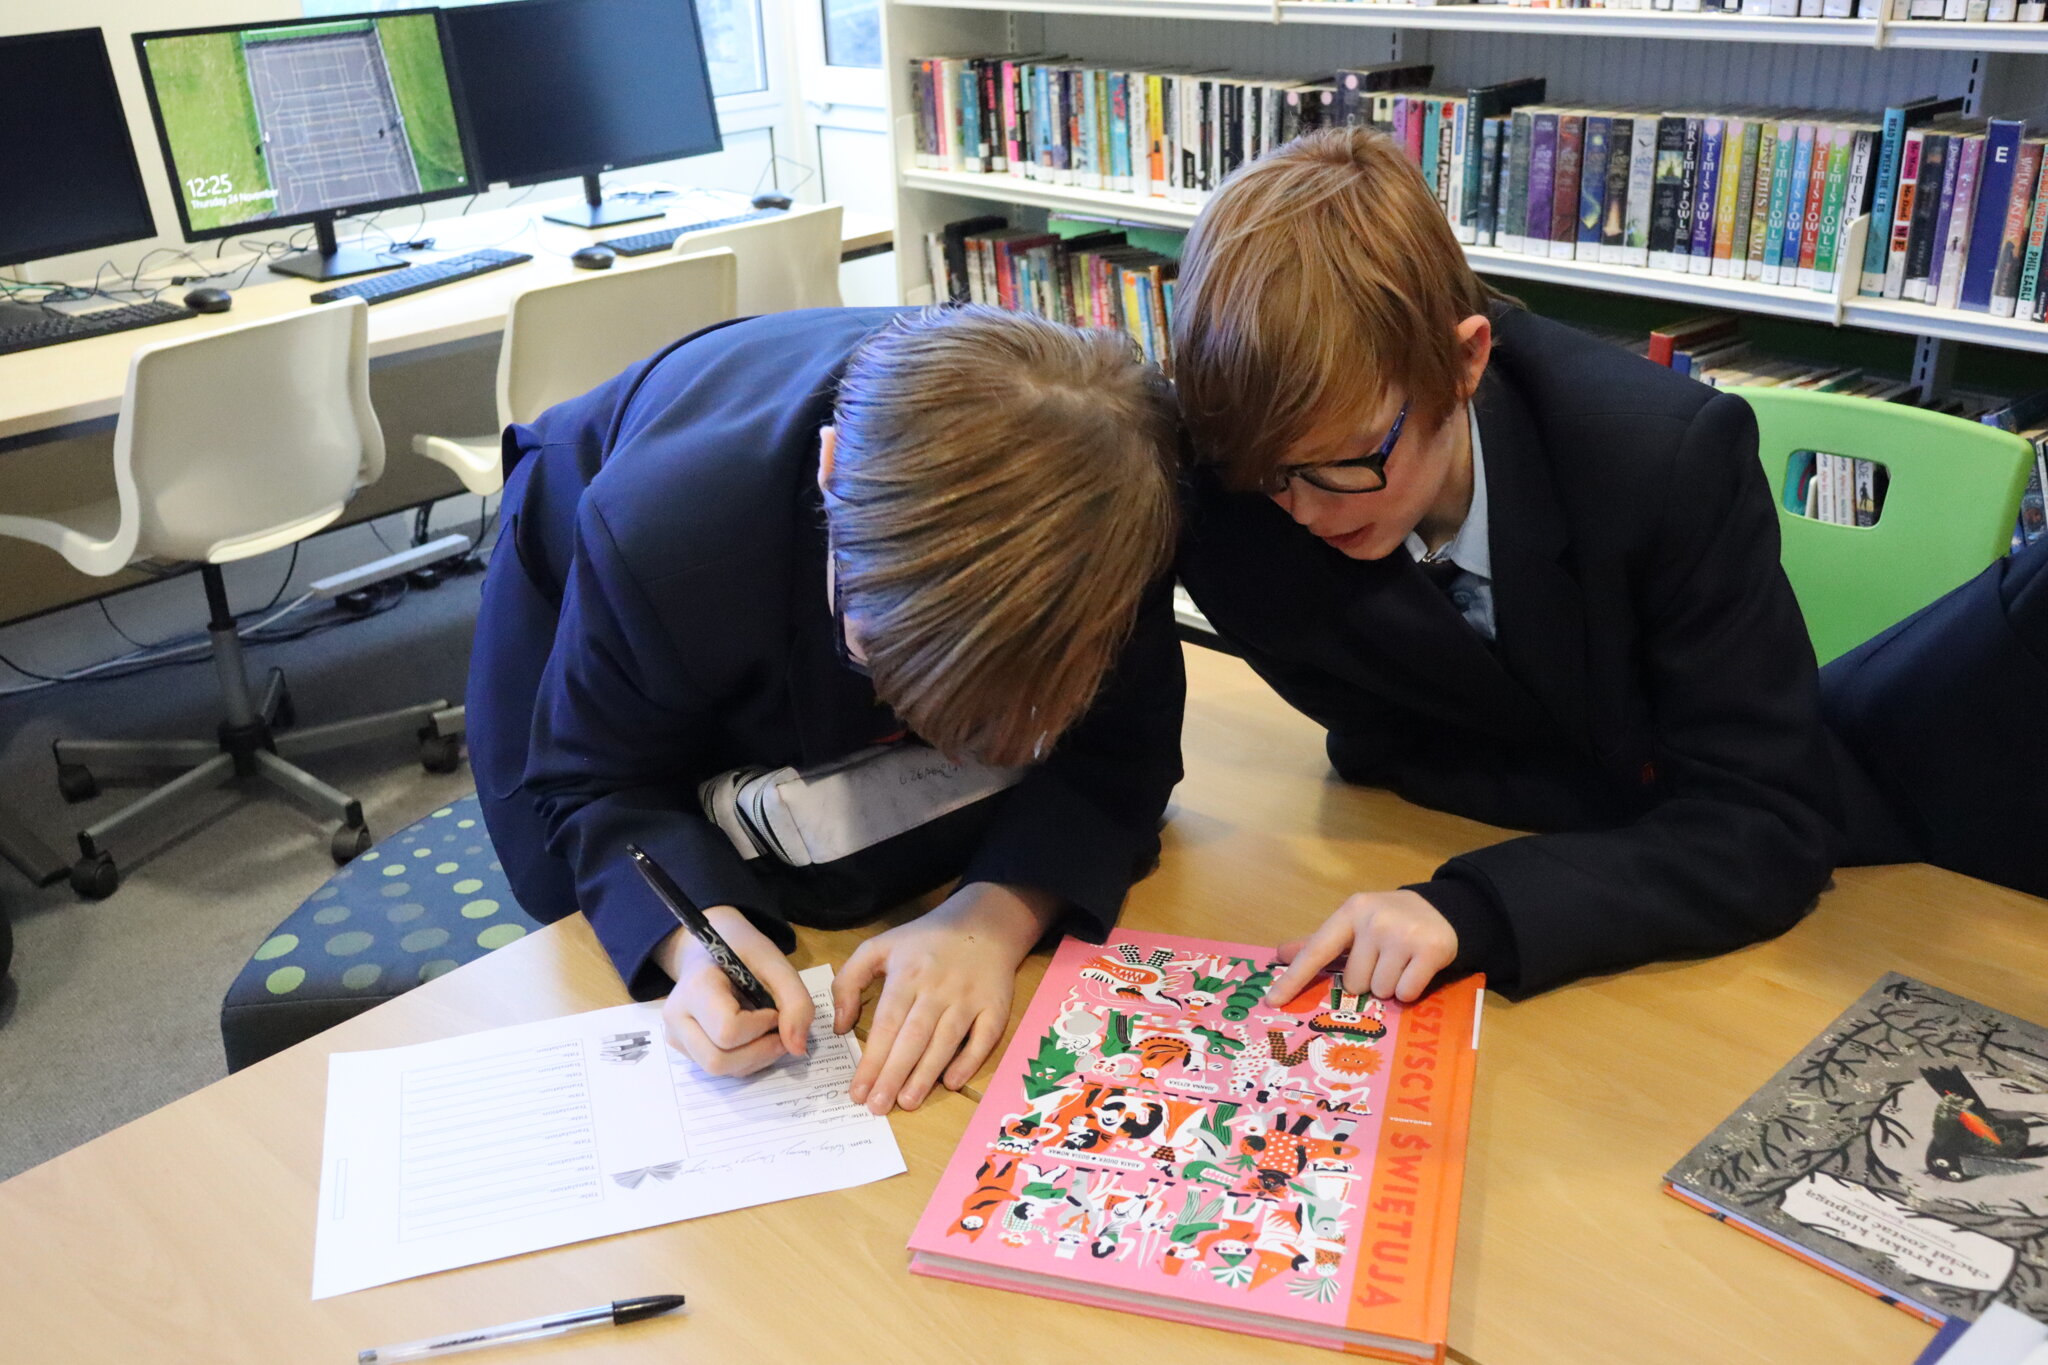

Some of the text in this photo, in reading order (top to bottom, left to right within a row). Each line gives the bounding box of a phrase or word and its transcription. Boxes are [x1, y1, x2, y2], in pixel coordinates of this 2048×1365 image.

[1682, 120, 1697, 188] ARTEMIS
[1702, 134, 1717, 190] RTEMIS
[1775, 140, 1793, 198] RTEMIS
[1812, 141, 1826, 200] RTEMIS
[1850, 134, 1869, 203] ARTEMIS
[1882, 138, 1894, 174] BETWEEN
[1995, 147, 2009, 163] E
[186, 173, 233, 198] 12:25
[191, 197, 227, 210] Thursday
[239, 188, 279, 202] November
[1787, 140, 1809, 241] RTEMIS FOWL
[1881, 174, 1889, 189] THE
[1677, 191, 1690, 229] FOWL
[1697, 192, 1710, 230] FOWL
[1769, 202, 1783, 240] FOWL
[1804, 203, 1819, 242] FOWL
[1821, 206, 1835, 246] FOWL
[2034, 201, 2047, 230] WRAP
[2025, 250, 2039, 272] PHIL
[1168, 1079, 1214, 1092] JOANNA RZYSKA
[1046, 1148, 1140, 1169] AGATA DUDEK GOSIA NOWAK
[1356, 1133, 1418, 1311] ŚWIĘTUJĄ
[1804, 1186, 1868, 1226] papugą
[1821, 1207, 1870, 1238] który
[1870, 1219, 1927, 1255] zostać
[1937, 1264, 1954, 1279] O
